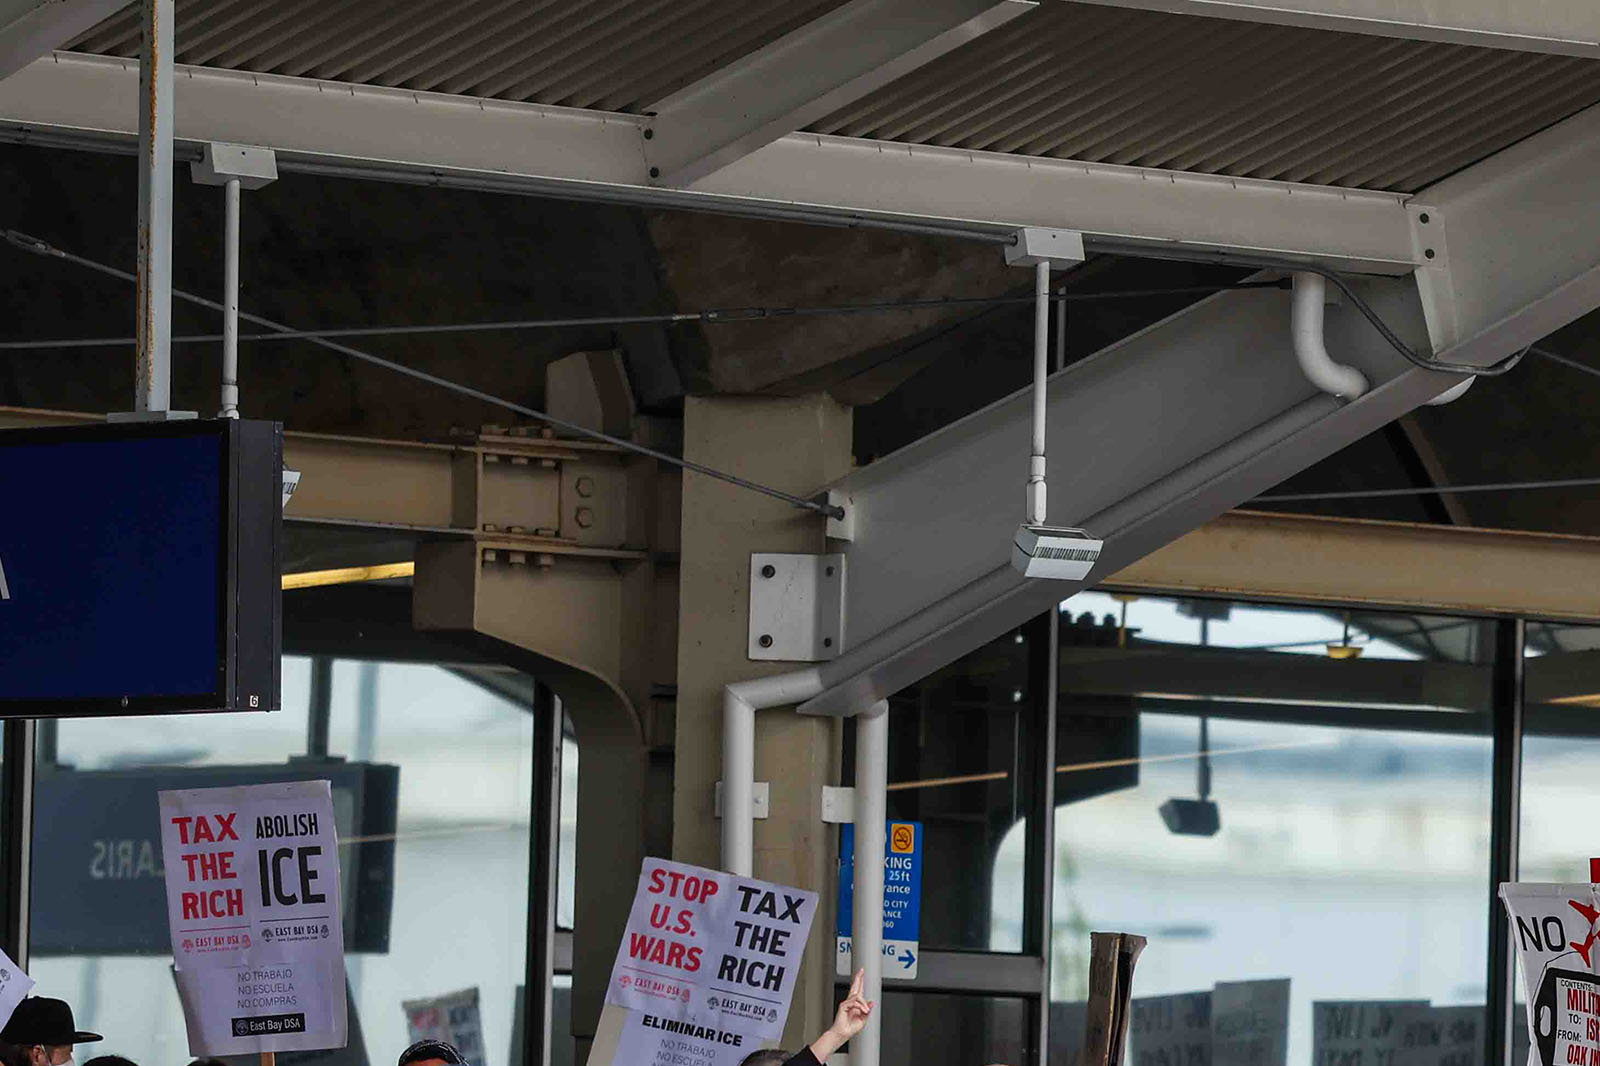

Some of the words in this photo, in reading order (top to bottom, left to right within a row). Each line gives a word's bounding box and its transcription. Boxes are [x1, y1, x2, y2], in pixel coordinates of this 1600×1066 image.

[171, 813, 239, 844] TAX
[256, 813, 319, 839] ABOLISH
[181, 852, 237, 881] THE
[258, 846, 326, 907] ICE
[648, 868, 719, 904] STOP
[181, 889, 244, 920] RICH
[737, 884, 805, 924] TAX
[275, 927, 291, 936] EAST
[307, 925, 318, 934] DSA
[650, 904, 697, 937] U.S.
[1516, 915, 1566, 952] NO
[734, 920, 791, 957] THE
[629, 933, 703, 972] WARS
[238, 972, 251, 982] NO
[253, 969, 292, 980] TRABAJO
[634, 977, 651, 989] EAST
[668, 984, 680, 995] DSA
[717, 954, 785, 992] RICH
[237, 1000, 250, 1009] NO
[253, 995, 297, 1007] COMPRAS
[238, 986, 251, 995] NO
[253, 983, 294, 994] ESCUELA
[722, 999, 737, 1010] EAST
[740, 1002, 752, 1013] BAY
[753, 1005, 766, 1016] DSA
[1568, 1013, 1582, 1025] TO:
[249, 1021, 266, 1032] East
[268, 1020, 282, 1032] Bay
[284, 1018, 301, 1029] DSA
[642, 1014, 715, 1041] ELIMINAR
[717, 1032, 743, 1046] ICE
[1557, 1029, 1582, 1043] FROM:
[656, 1051, 671, 1061] NO
[660, 1039, 675, 1048] NO
[677, 1042, 716, 1058] TRABAJO
[1567, 1044, 1587, 1065] OAK
